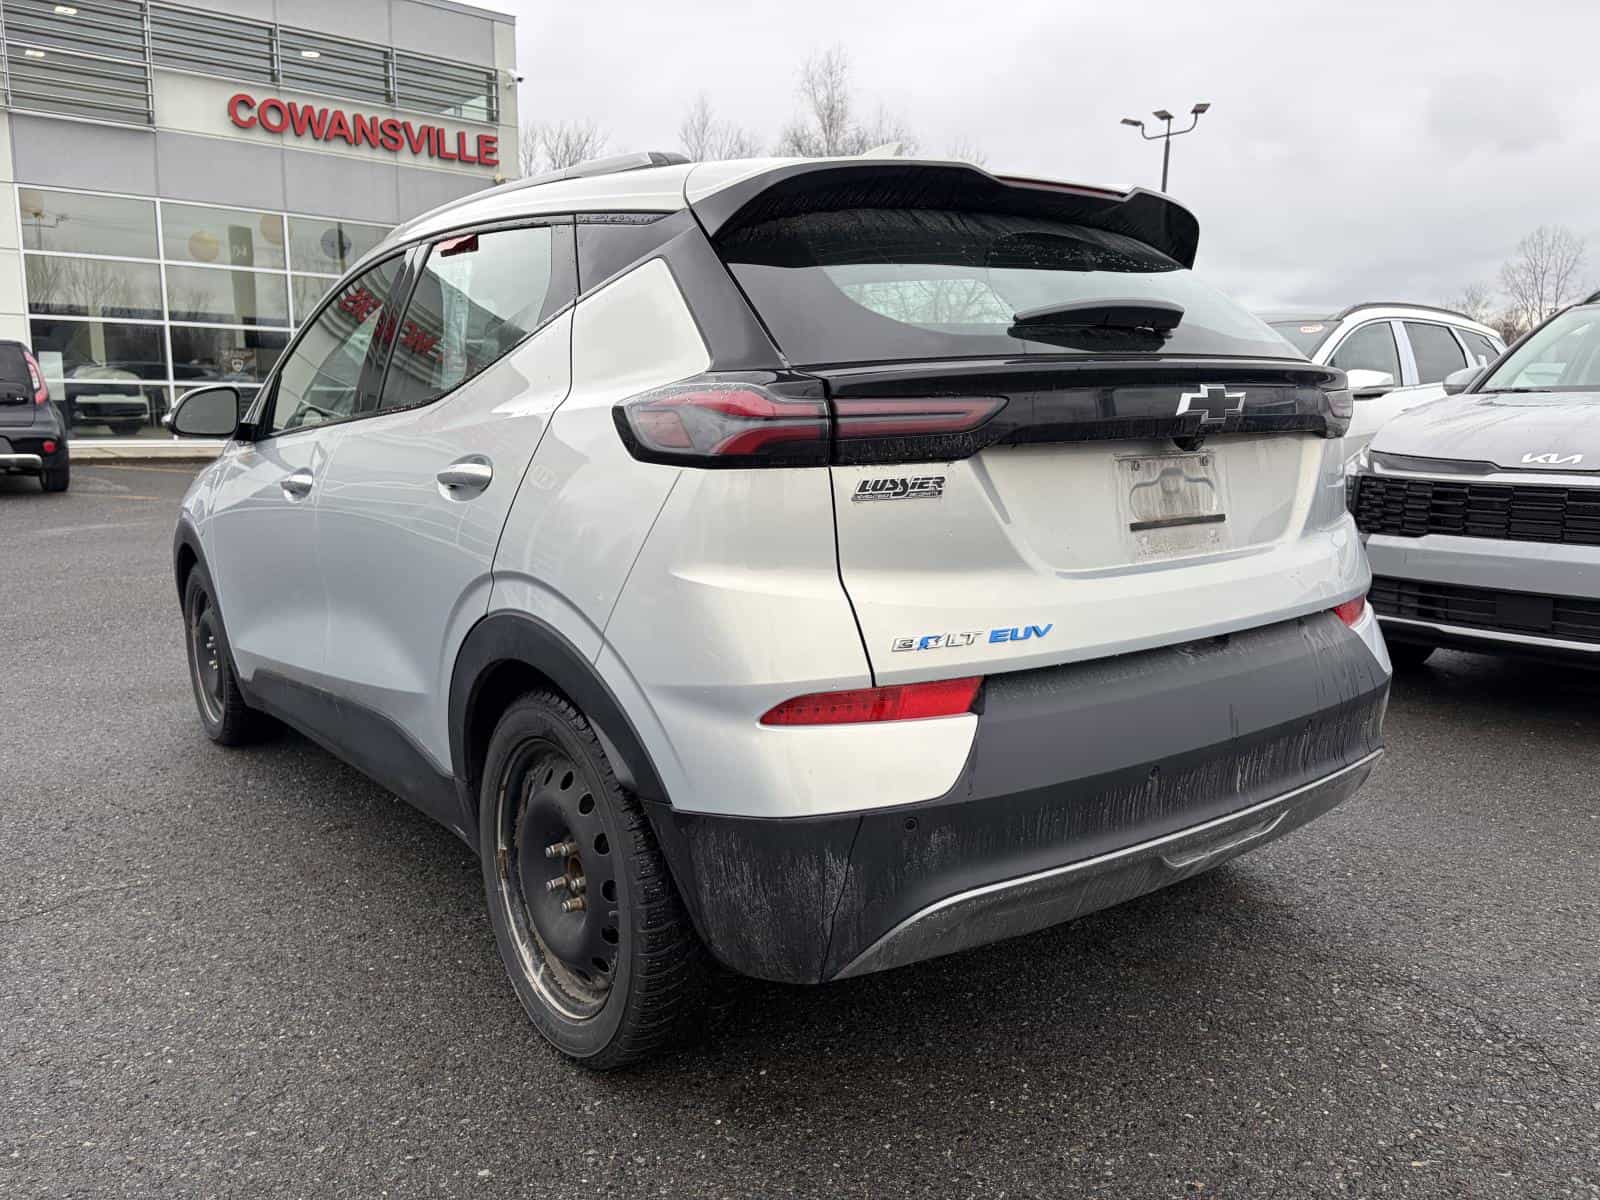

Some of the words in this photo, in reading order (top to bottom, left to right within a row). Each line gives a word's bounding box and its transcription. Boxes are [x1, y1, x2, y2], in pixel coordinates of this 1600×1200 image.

[228, 93, 499, 166] COWANSVILLE
[855, 476, 946, 498] LUSSIER
[891, 630, 986, 653] BOLT
[988, 623, 1053, 644] EUV
